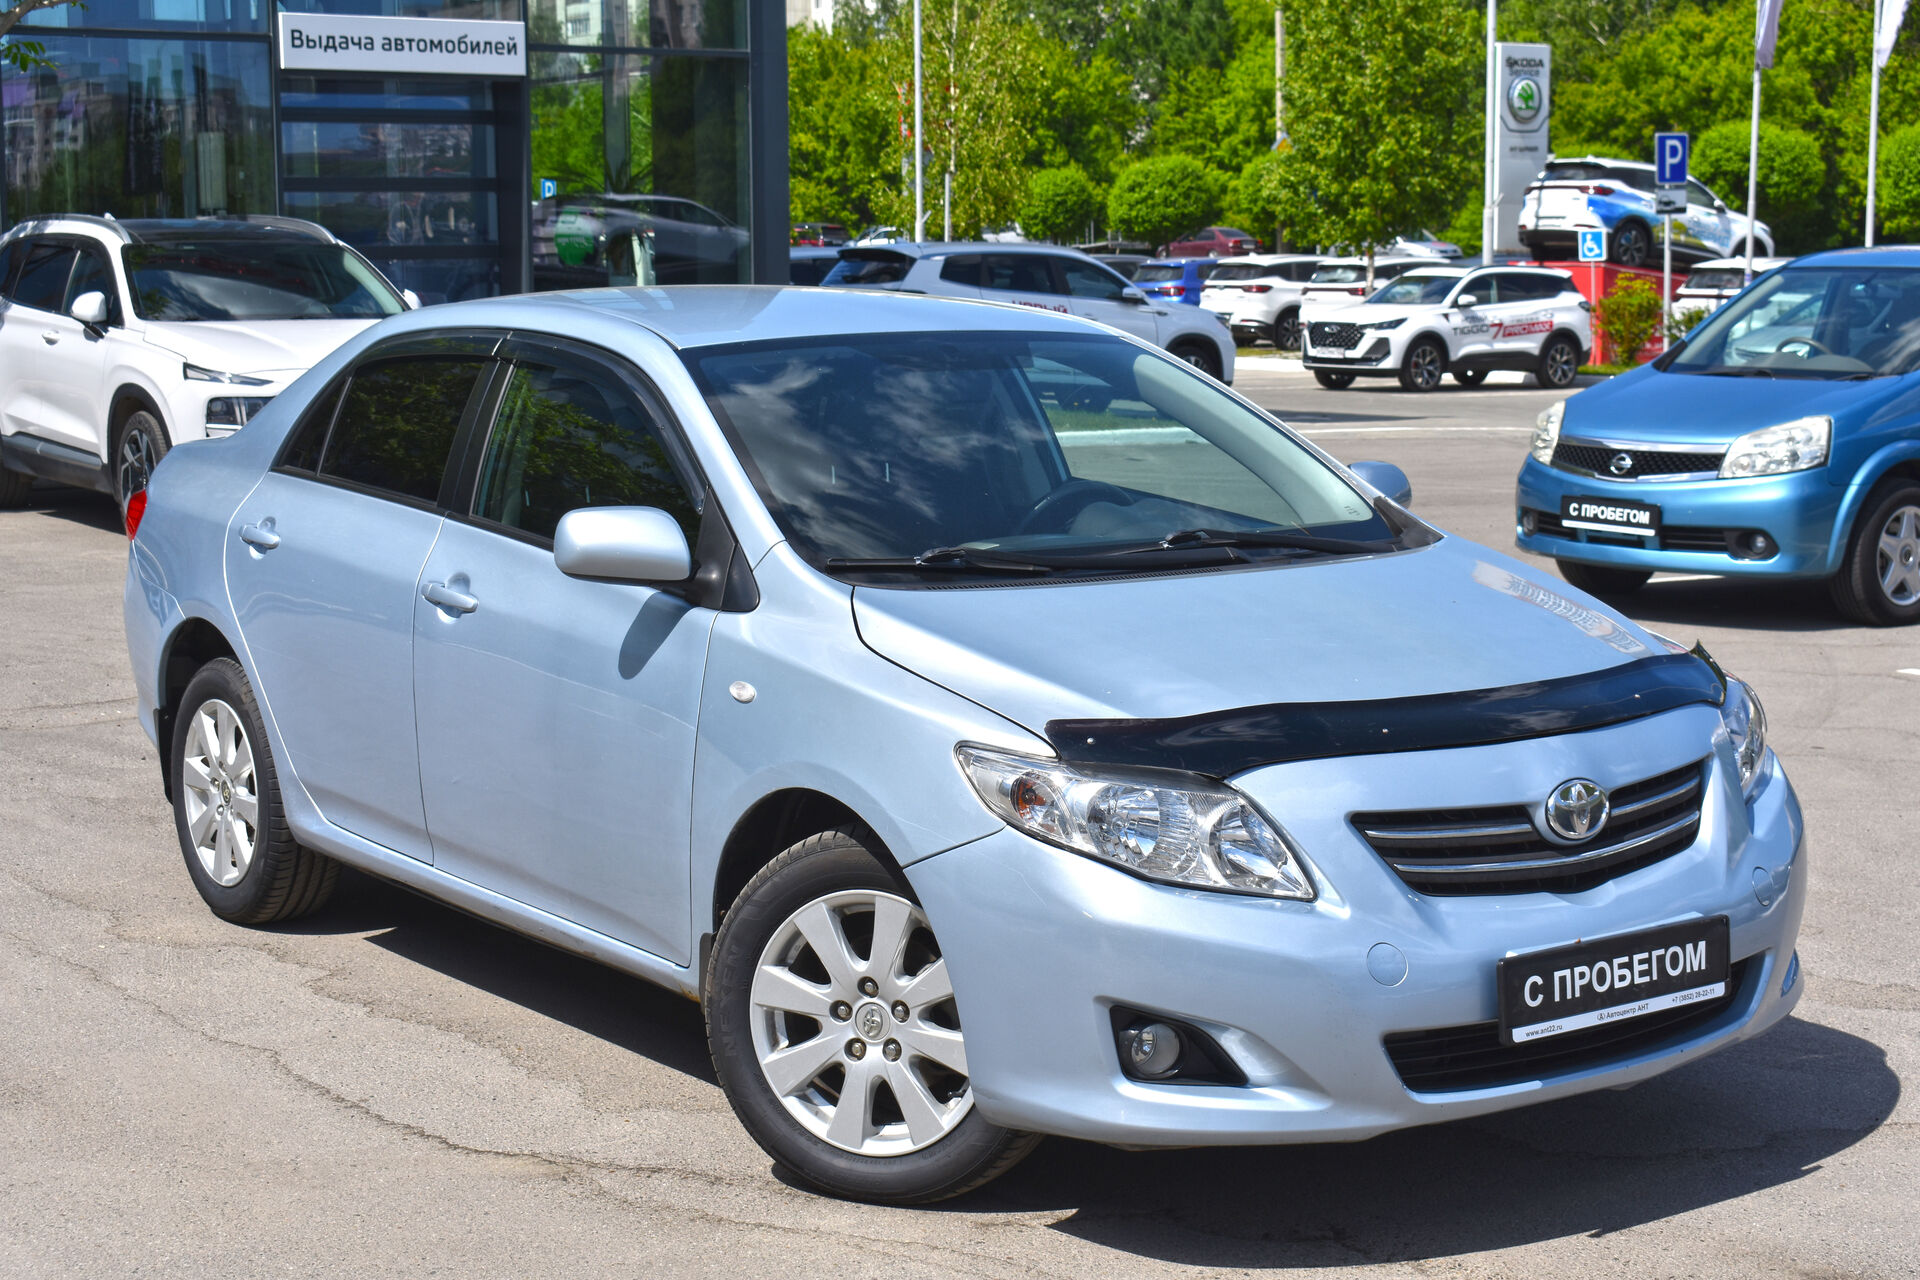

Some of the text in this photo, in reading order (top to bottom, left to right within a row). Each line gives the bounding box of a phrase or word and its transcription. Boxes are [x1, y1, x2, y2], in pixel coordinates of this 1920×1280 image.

[291, 29, 517, 55] Выдача автомобилей
[1665, 139, 1683, 179] P
[1452, 323, 1489, 336] TIGGO
[1490, 322, 1503, 339] 7
[1569, 503, 1650, 524] С ПРОБЕГОМ
[1524, 941, 1706, 1008] С ПРОБЕГОМ
[1525, 1025, 1563, 1037] www.ant22.ru
[1607, 1006, 1637, 1018] Автоцентр
[1637, 1003, 1649, 1012] АНТ
